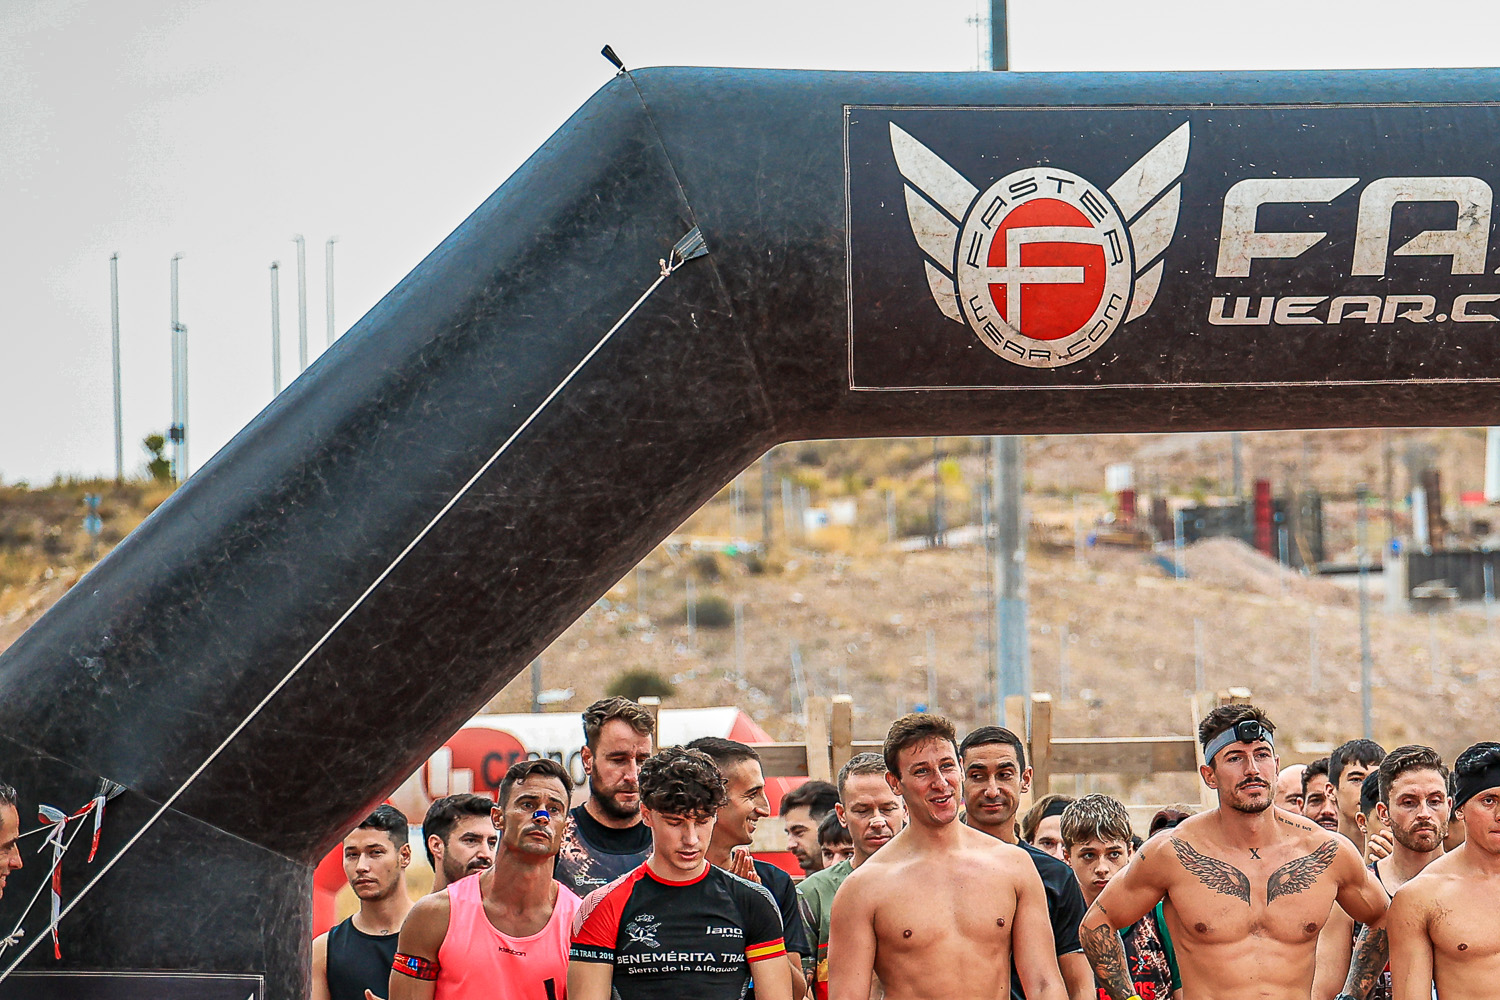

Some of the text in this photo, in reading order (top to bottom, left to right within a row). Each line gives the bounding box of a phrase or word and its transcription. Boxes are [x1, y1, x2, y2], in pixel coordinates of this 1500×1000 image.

[966, 175, 1125, 270] FASTER
[969, 291, 1123, 363] WEAR.COM
[616, 950, 716, 965] BENEMÉRITA
[628, 965, 659, 975] Sierra
[661, 965, 677, 973] de
[680, 964, 691, 972] la
